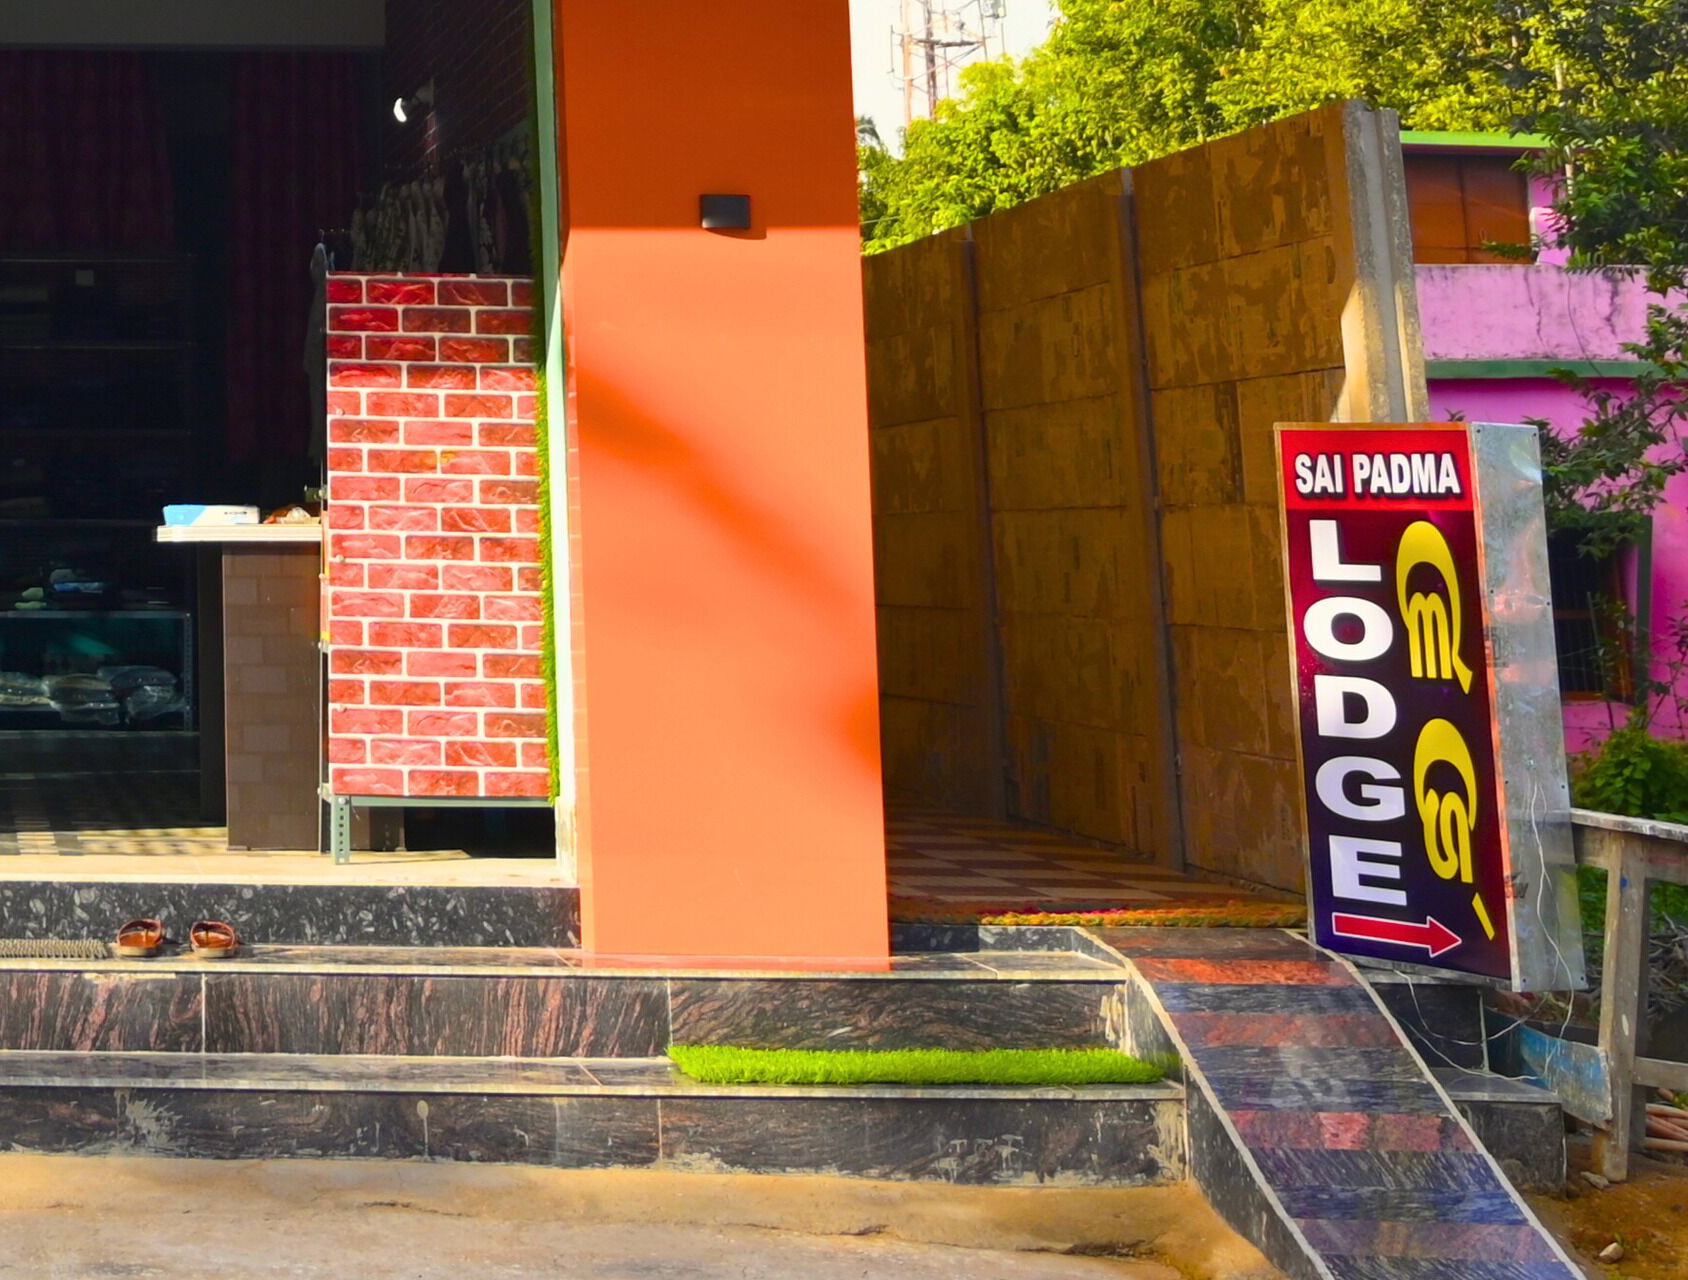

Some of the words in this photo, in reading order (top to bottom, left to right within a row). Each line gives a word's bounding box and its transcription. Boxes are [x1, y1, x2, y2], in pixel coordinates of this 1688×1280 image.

[1294, 453, 1345, 496] SAI
[1352, 453, 1462, 496] PADMA
[1303, 519, 1406, 906] LODGE
